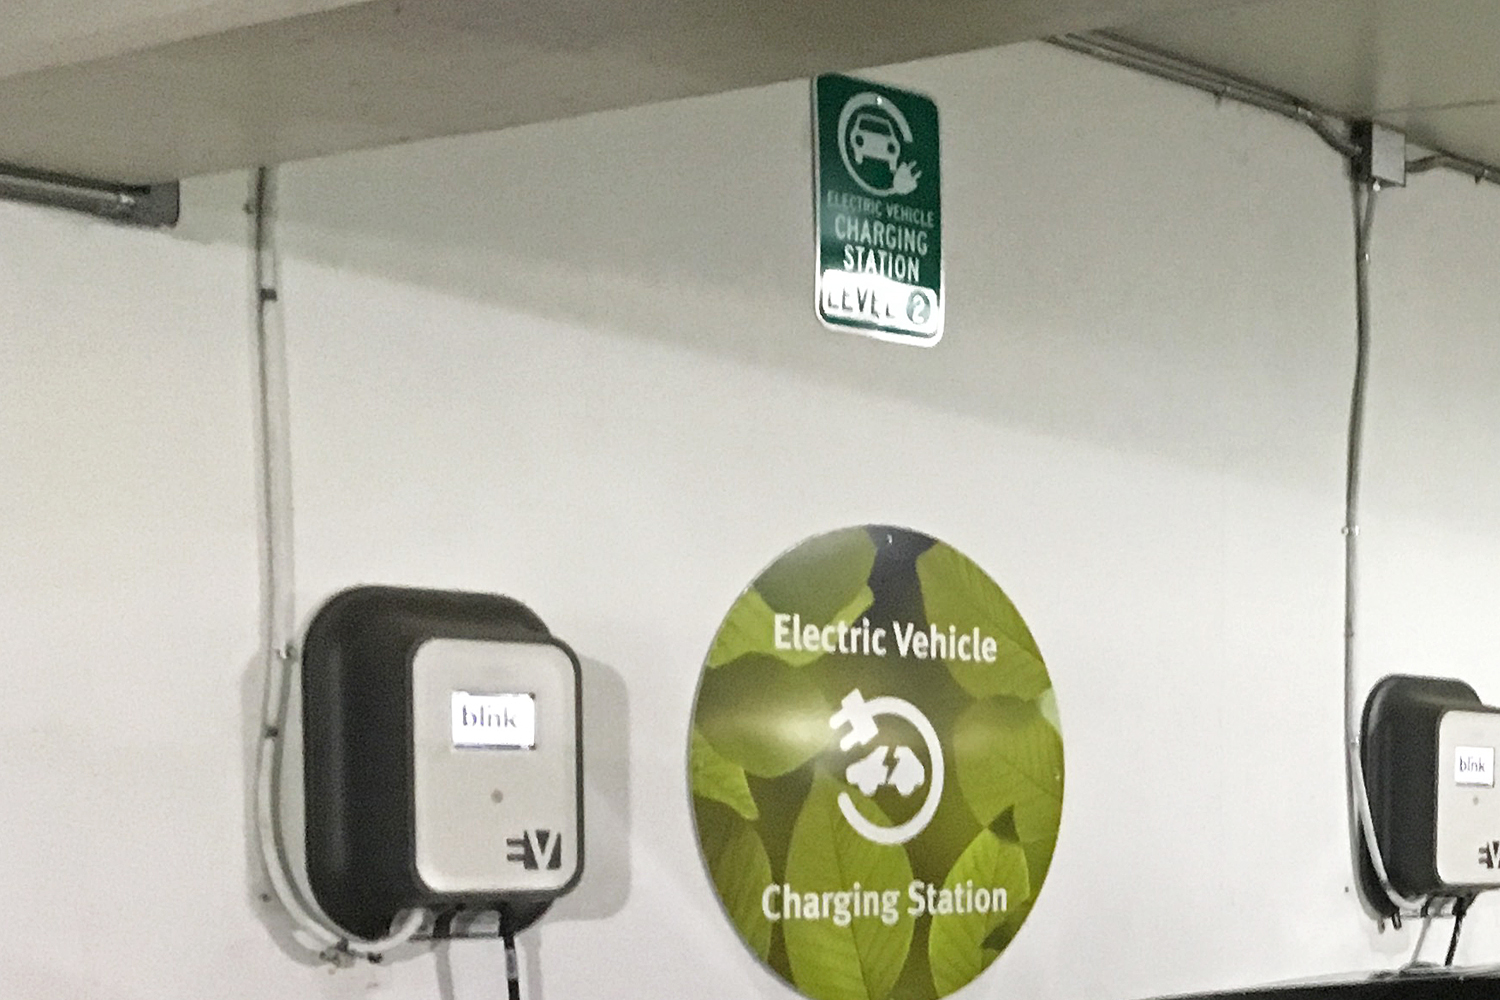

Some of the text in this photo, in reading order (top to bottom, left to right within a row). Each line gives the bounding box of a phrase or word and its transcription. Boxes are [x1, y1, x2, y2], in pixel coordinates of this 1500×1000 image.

[826, 190, 935, 229] ELECTRIC VEHICLE
[834, 213, 929, 256] CHARGING
[843, 244, 920, 283] STATION
[827, 286, 896, 319] LEVEL
[774, 613, 999, 664] Electric Vehicle
[462, 705, 518, 729] blink
[1459, 755, 1486, 773] blink
[762, 878, 1008, 927] Charging Station
